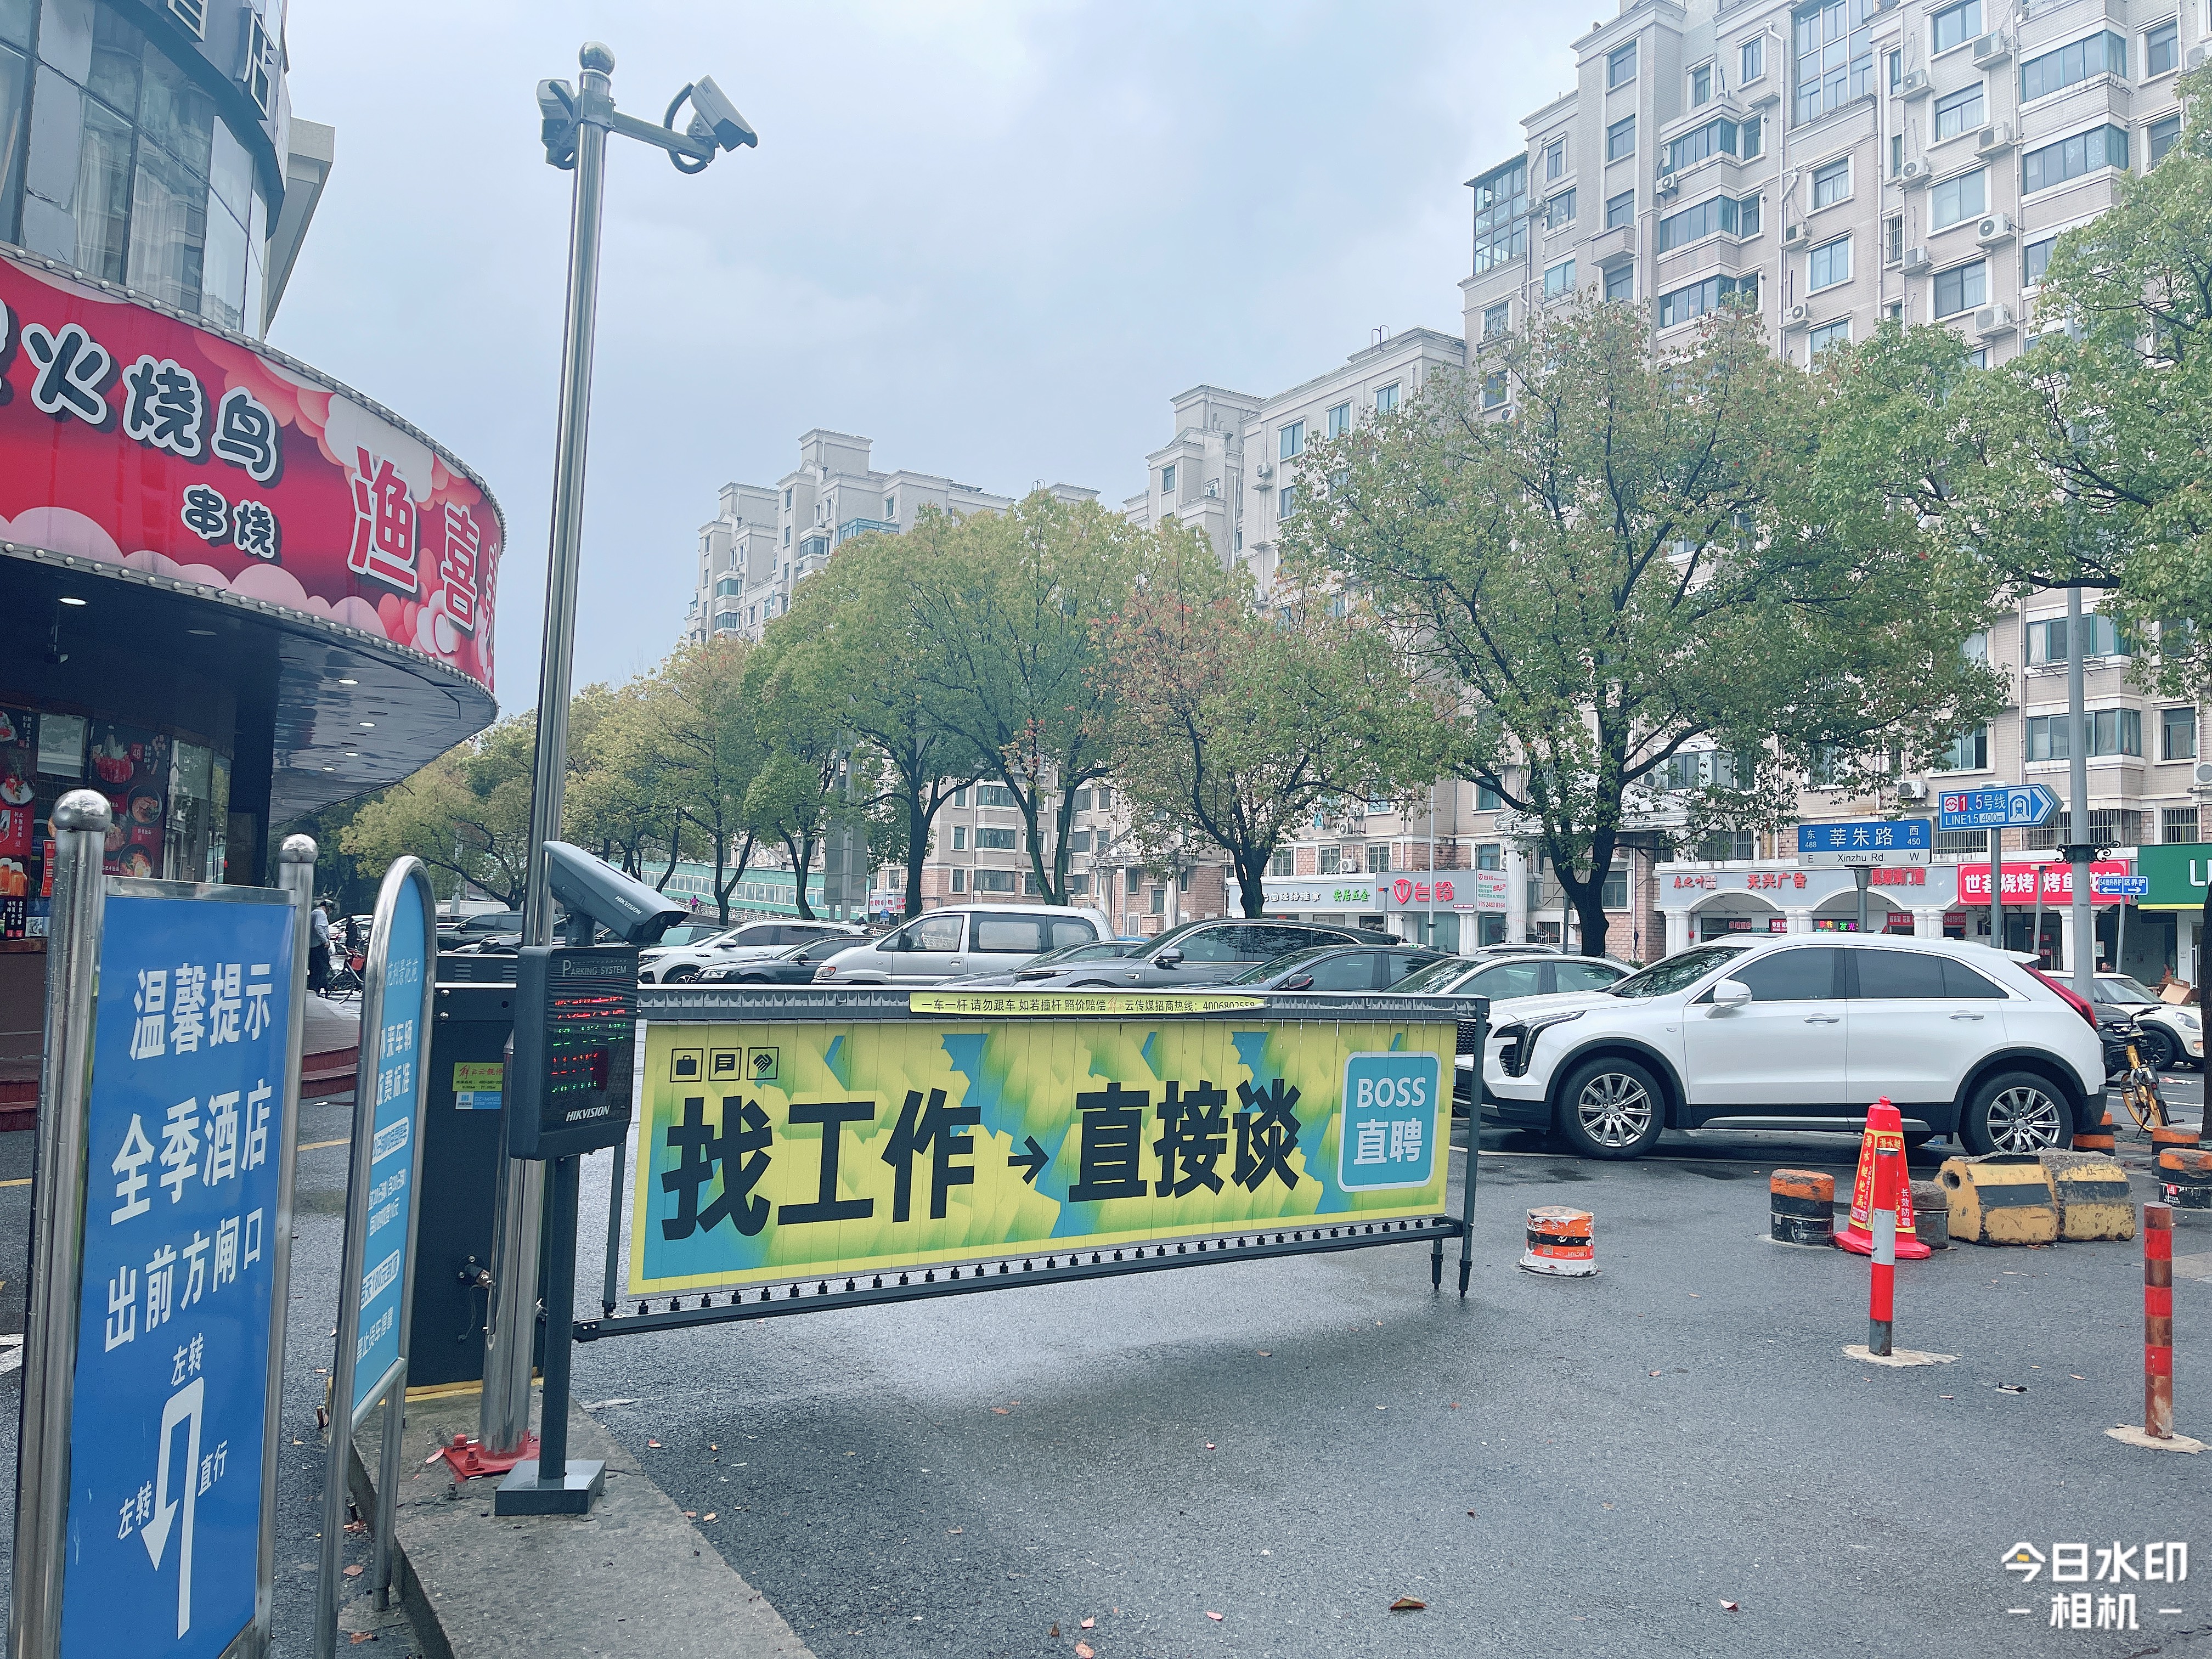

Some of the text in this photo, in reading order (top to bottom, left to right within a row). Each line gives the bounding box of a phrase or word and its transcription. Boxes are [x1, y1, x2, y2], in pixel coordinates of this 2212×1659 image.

[0, 299, 278, 482] 火烧鸟
[182, 484, 276, 560] 串烧
[1807, 825, 1920, 848] 东 莘朱路 西
[1808, 855, 1814, 863] E
[1837, 853, 1866, 862] Xinzhu
[1910, 853, 1920, 861] W
[1333, 888, 1370, 902] 安居五金
[1415, 881, 1454, 901] 台铃
[1747, 872, 1807, 889] 天兴广告
[614, 895, 642, 915] HIKVISION
[129, 963, 272, 1060] 温馨提示
[921, 998, 968, 1012] 一车一杆
[970, 998, 1015, 1012] 请勿跟车
[1019, 998, 1062, 1012] 如若撞杆
[566, 1105, 611, 1122] HIKVISION
[1357, 1076, 1426, 1108] BOSS
[111, 1078, 272, 1226] 全季酒店
[661, 1078, 1302, 1240] 找工作 直接谈
[1353, 1118, 1424, 1165] 直聘
[105, 1207, 263, 1352] 出前方闸口
[171, 1333, 204, 1386] 左转
[198, 1440, 228, 1498] 直行
[118, 1480, 153, 1540] 左转
